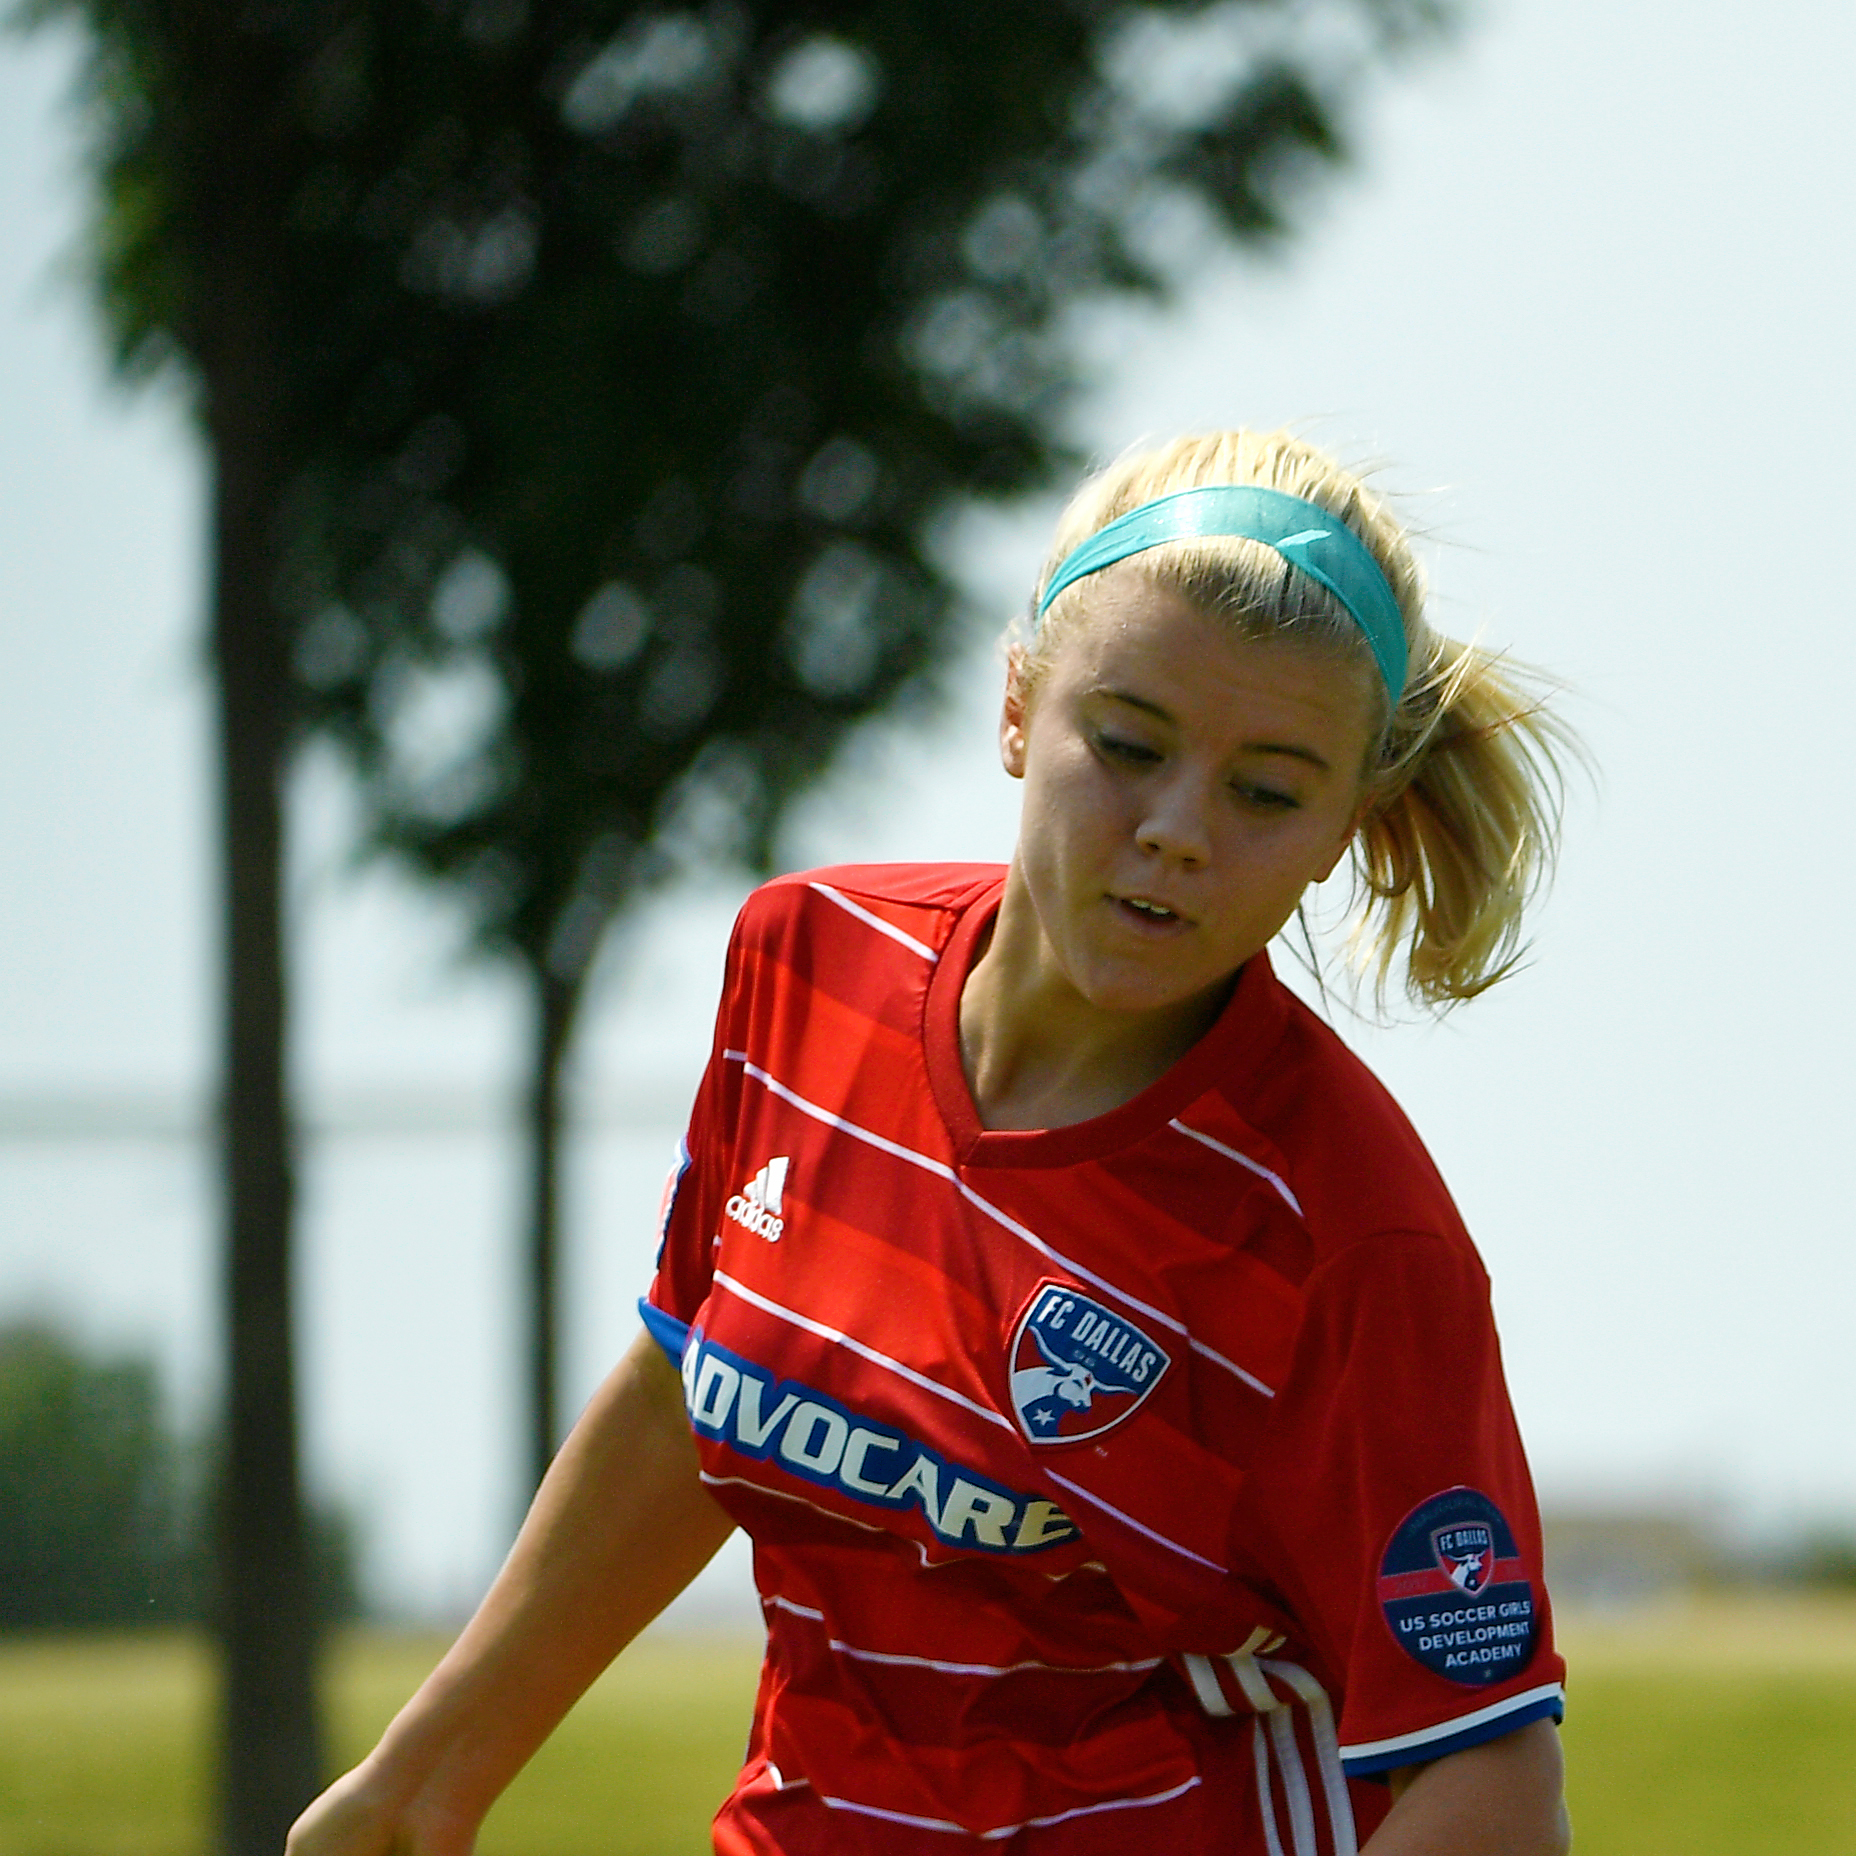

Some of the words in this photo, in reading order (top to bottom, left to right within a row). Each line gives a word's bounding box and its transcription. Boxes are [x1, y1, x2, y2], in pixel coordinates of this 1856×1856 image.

[725, 1195, 784, 1242] adidas
[1037, 1295, 1076, 1330] FC
[1071, 1310, 1157, 1383] DALLAS
[1440, 1534, 1454, 1550] FC
[1456, 1528, 1488, 1547] DALLAS
[1400, 1616, 1426, 1633] US
[1429, 1604, 1497, 1628] SOCCER
[1499, 1600, 1531, 1617] GIRLS
[1418, 1621, 1530, 1651] DEVELOPMENT
[1445, 1643, 1522, 1668] ACADEMY
